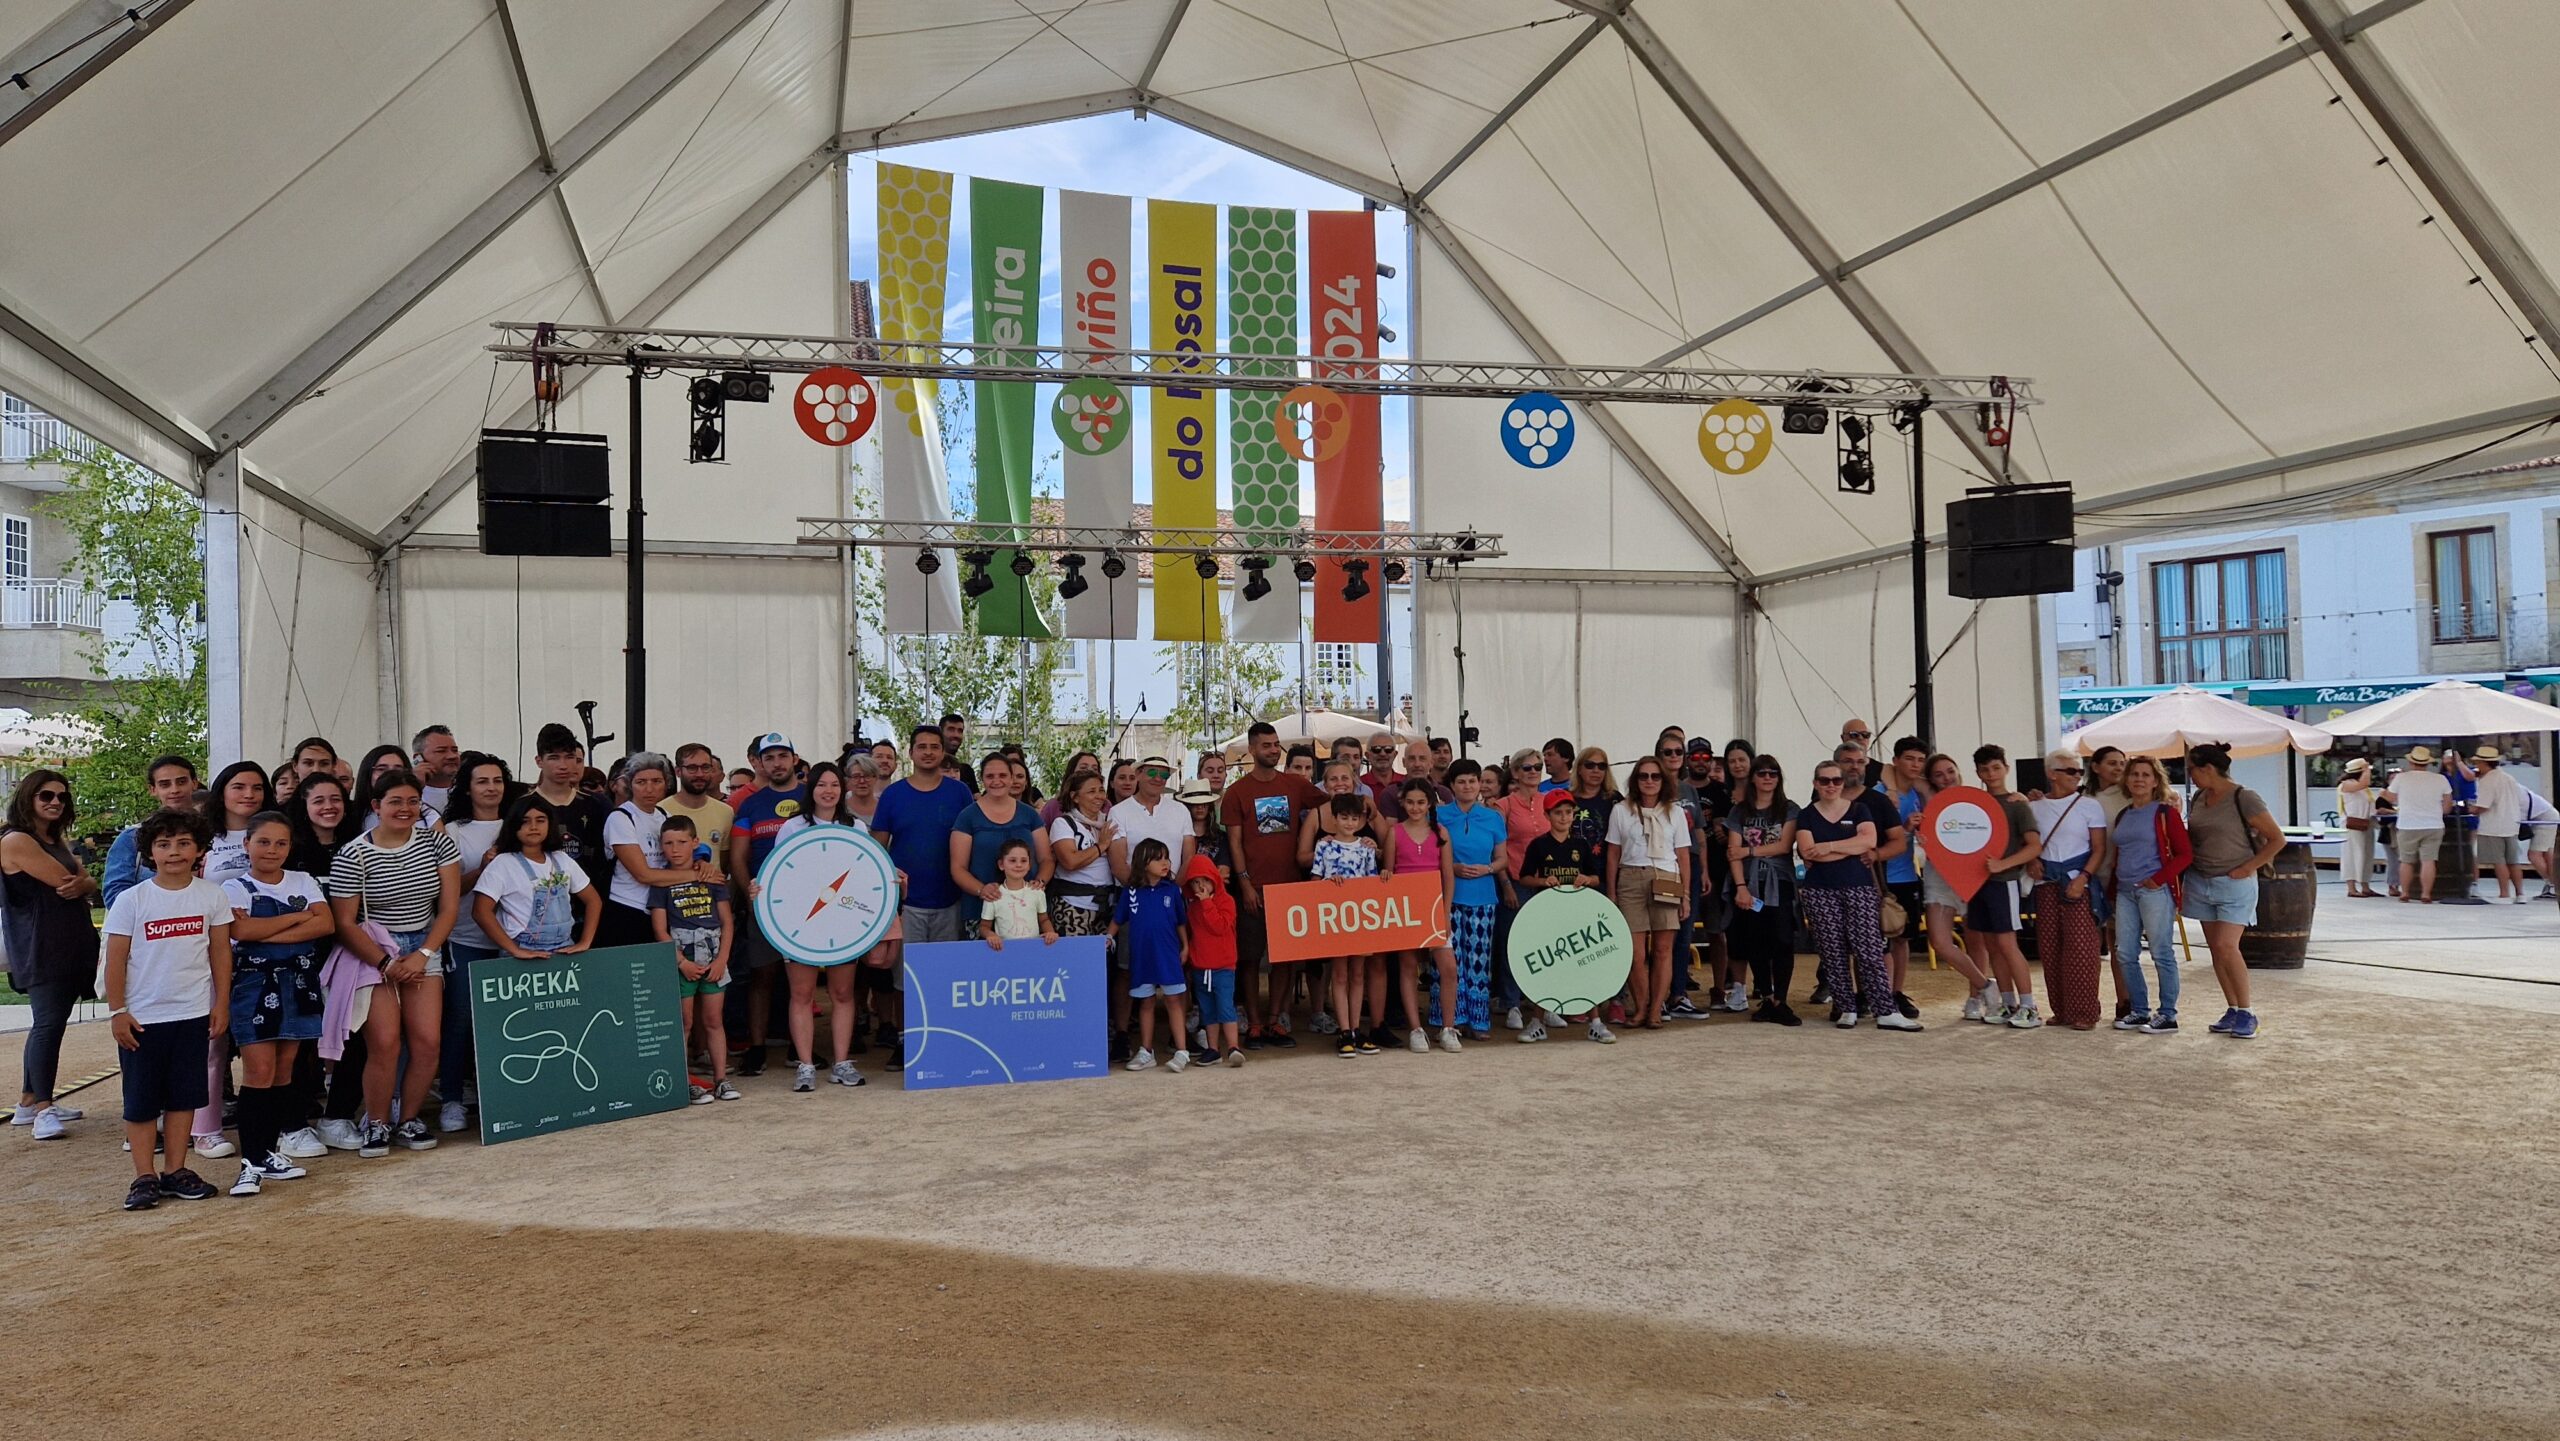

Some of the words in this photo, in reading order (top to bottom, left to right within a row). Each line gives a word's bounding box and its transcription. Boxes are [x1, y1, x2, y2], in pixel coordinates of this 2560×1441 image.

[1077, 258, 1116, 364] viño
[1167, 416, 1203, 481] do
[147, 921, 203, 937] Supreme
[1287, 905, 1308, 938] O
[1318, 896, 1422, 935] ROSAL
[1577, 953, 1596, 967] RETO
[1595, 943, 1620, 960] RURAL
[534, 1001, 555, 1011] RETO
[556, 998, 581, 1008] RURAL
[1011, 1010, 1035, 1021] RETO
[1036, 1009, 1067, 1020] RURAL
